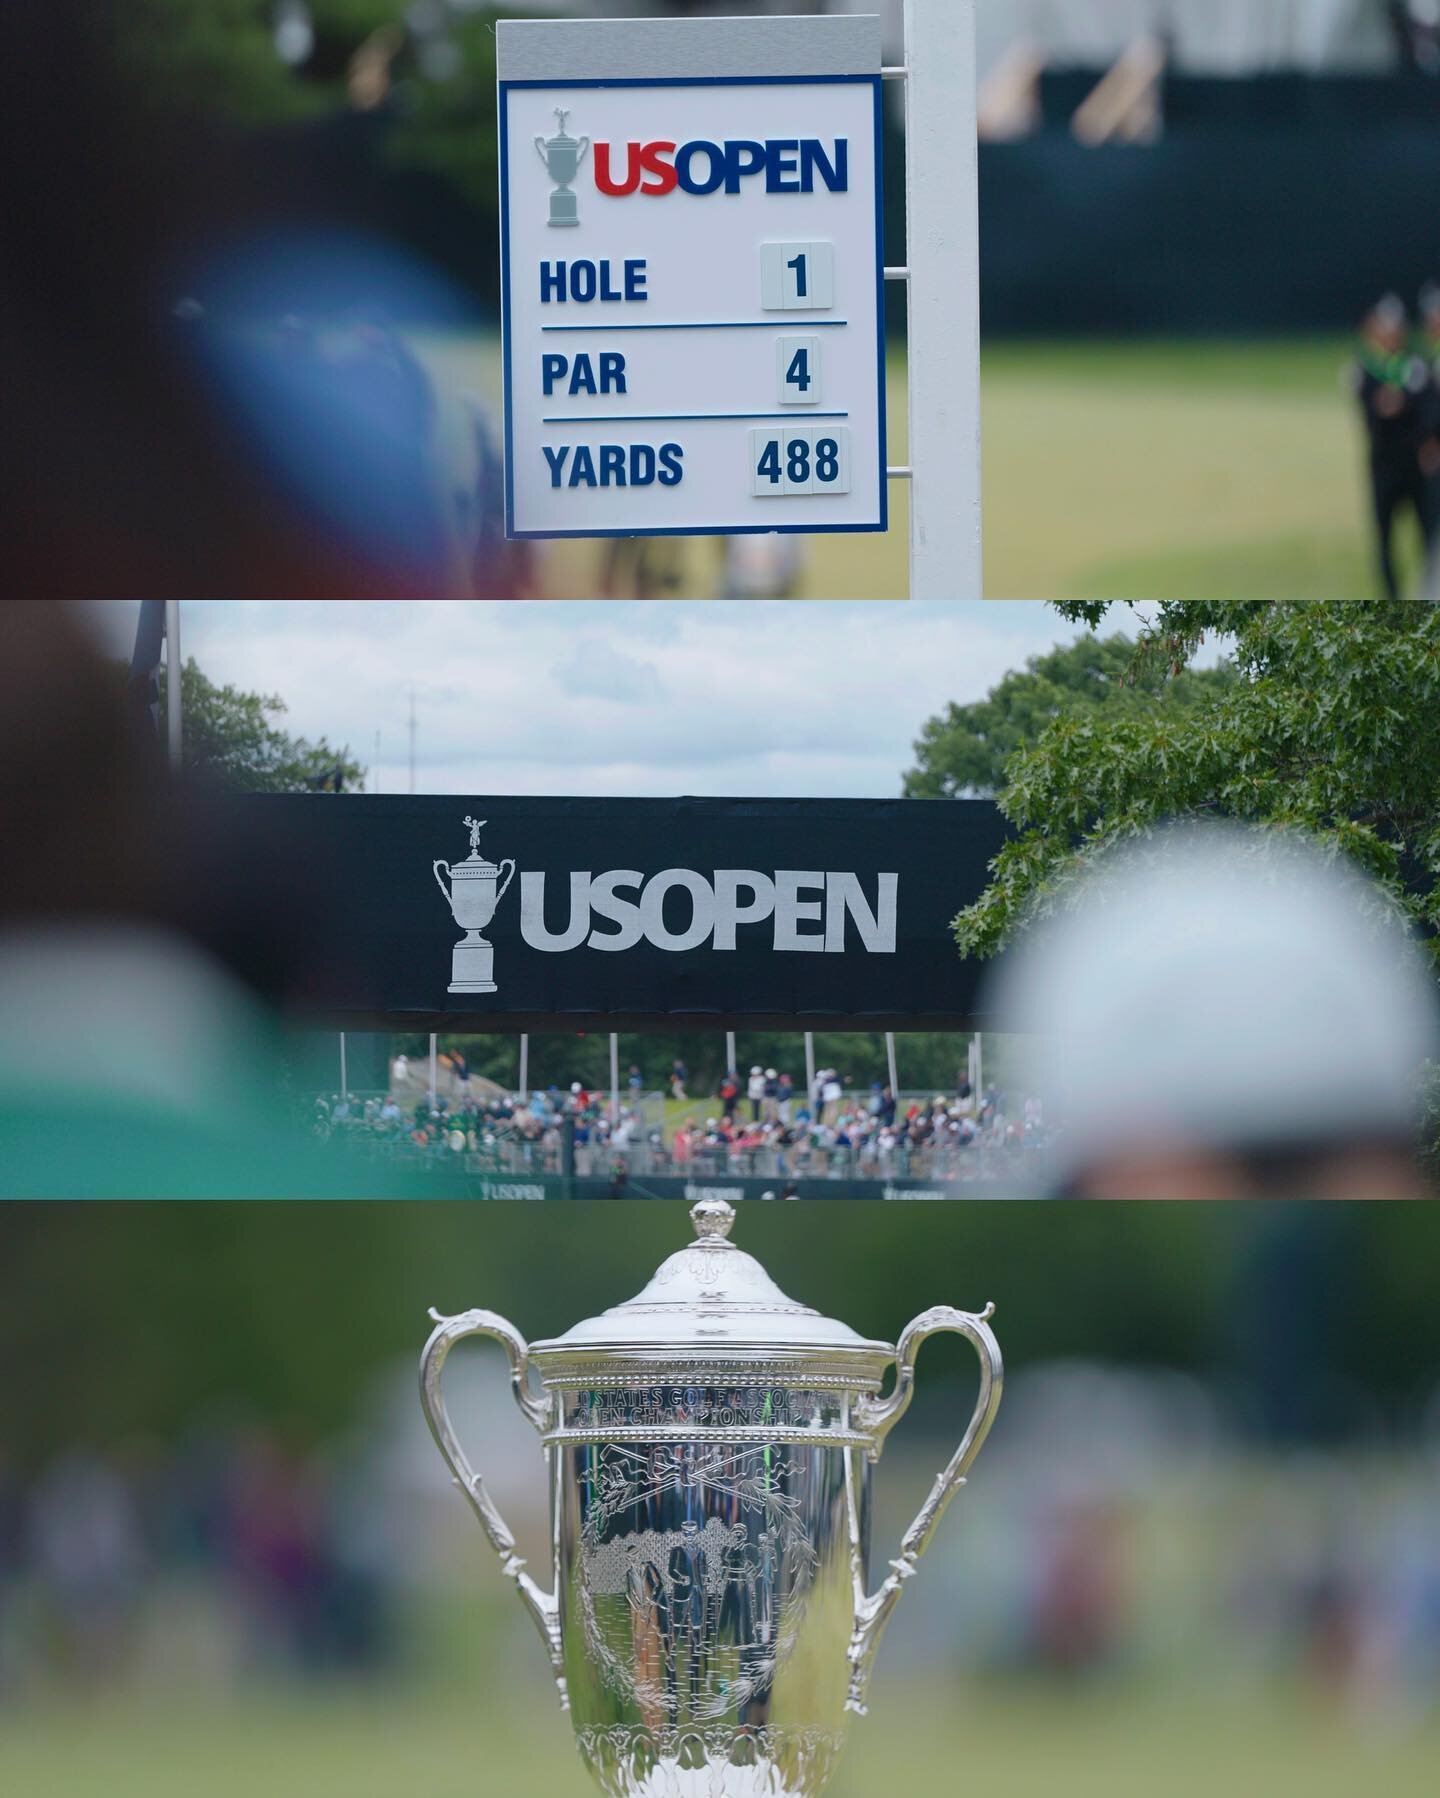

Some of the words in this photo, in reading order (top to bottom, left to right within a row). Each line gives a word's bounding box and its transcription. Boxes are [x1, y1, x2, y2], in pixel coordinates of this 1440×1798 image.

[540, 259, 648, 303] HOLE
[787, 253, 808, 298] 1
[542, 352, 627, 396] PAR
[785, 348, 811, 392] 4
[543, 443, 685, 488] YARDS
[757, 439, 840, 485] 488
[594, 1388, 663, 1408] STATES
[668, 1387, 727, 1407] GOLF
[631, 1407, 802, 1427] CHAMPIONSHIP
